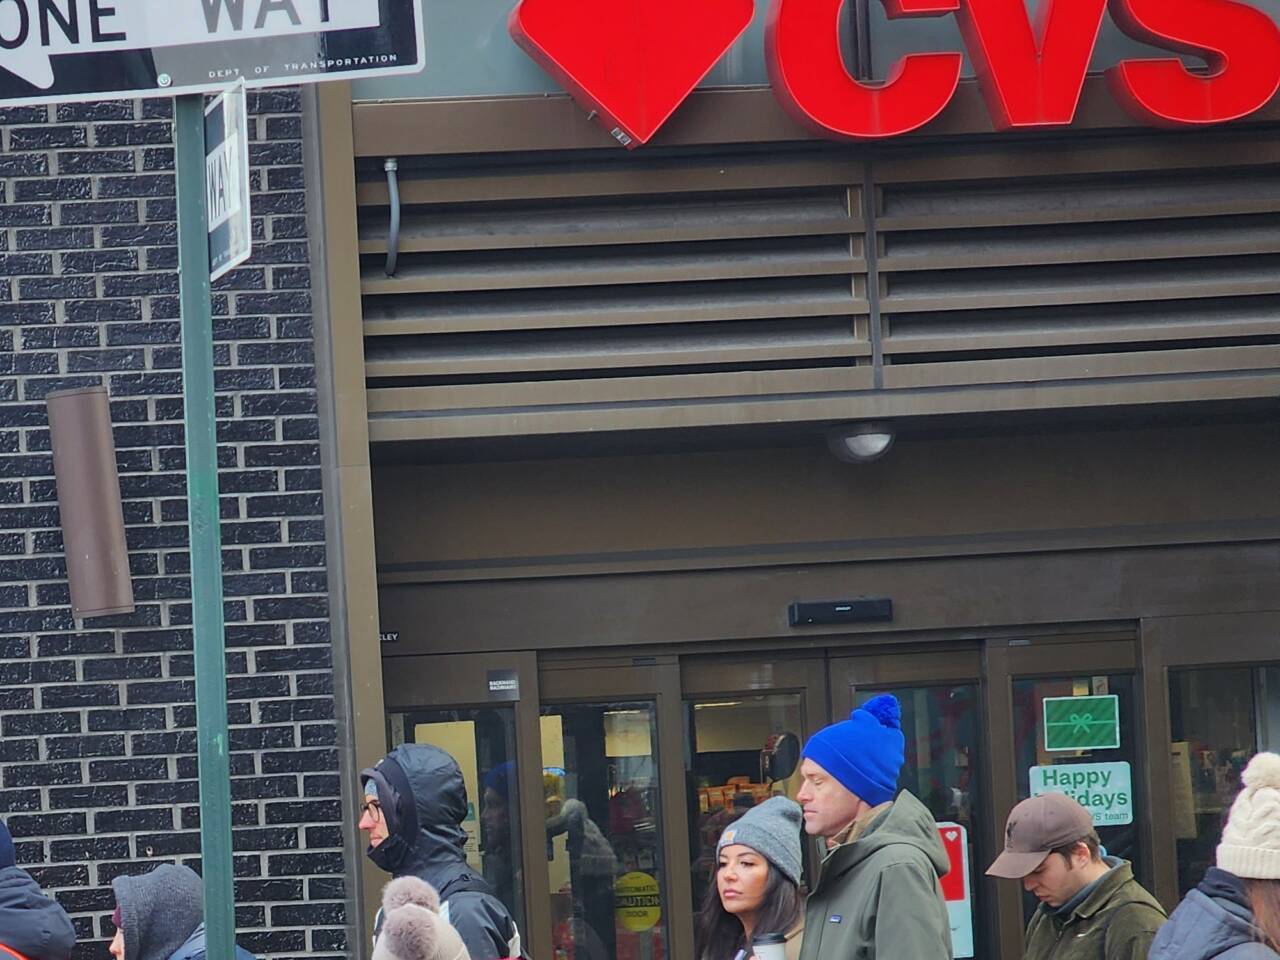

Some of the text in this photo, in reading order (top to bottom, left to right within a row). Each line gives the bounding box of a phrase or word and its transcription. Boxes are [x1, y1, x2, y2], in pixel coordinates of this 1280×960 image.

[208, 54, 398, 79] DEPT OF TRANSPORTATION
[765, 0, 1280, 138] CVS
[1042, 769, 1111, 789] Happy
[1105, 811, 1129, 821] team
